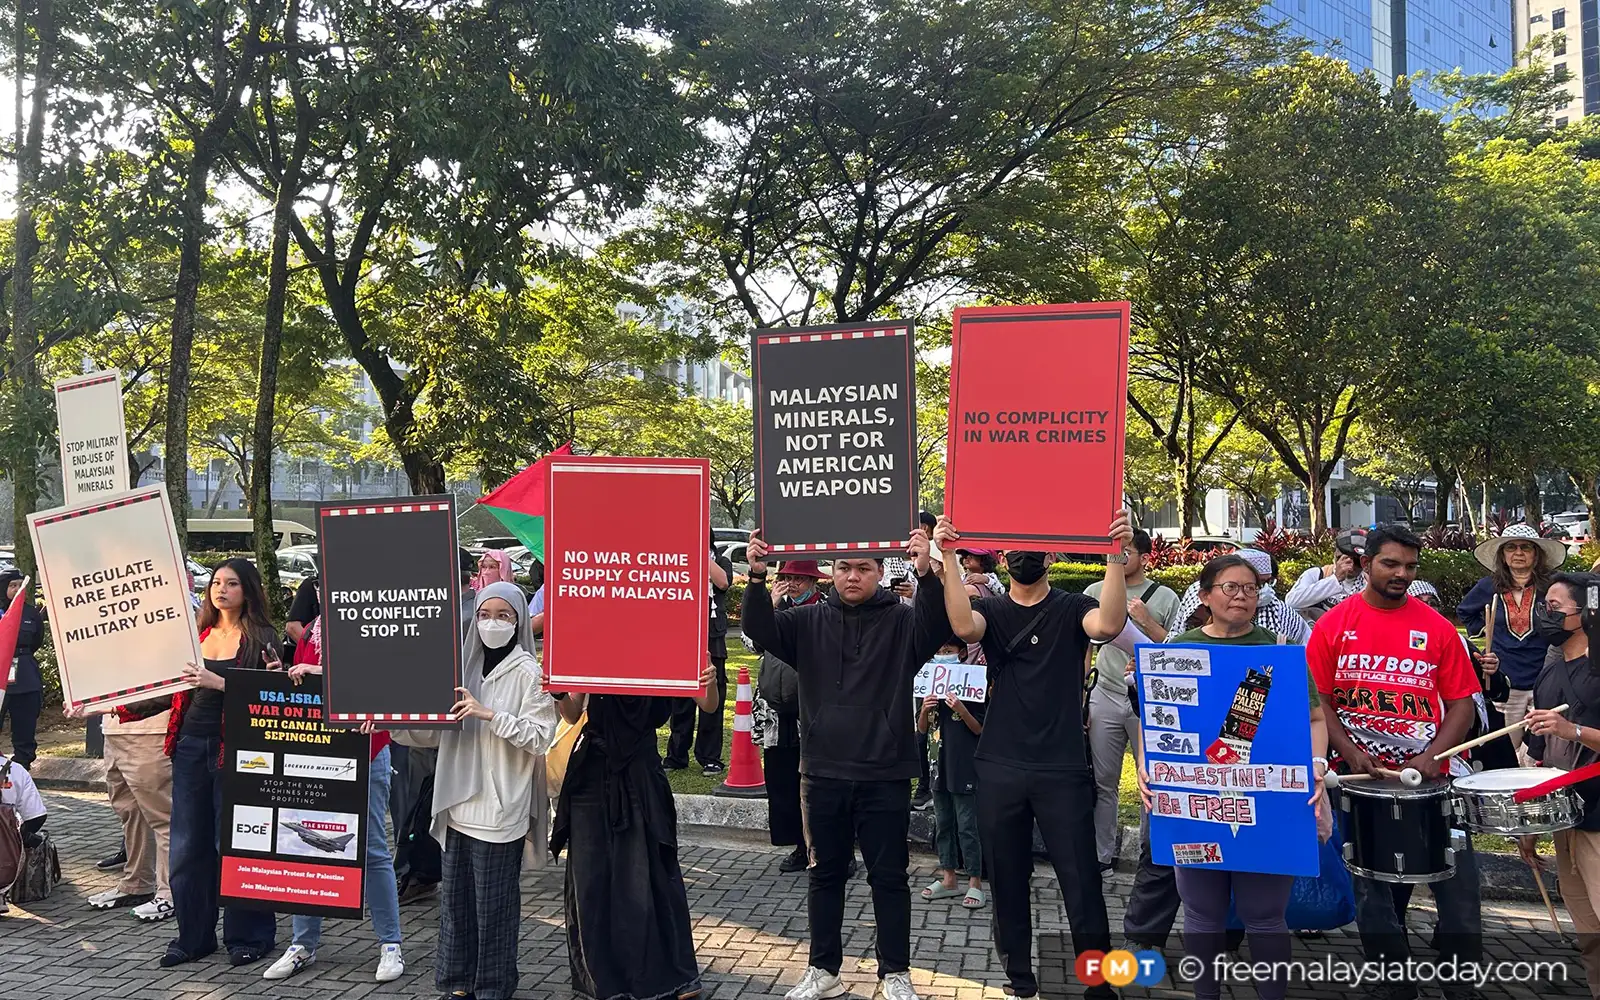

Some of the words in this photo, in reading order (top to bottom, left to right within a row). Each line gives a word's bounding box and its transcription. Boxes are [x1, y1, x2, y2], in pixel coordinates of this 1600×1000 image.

[770, 383, 898, 407] MALAYSIAN
[774, 407, 895, 429] MINERALS,
[964, 411, 990, 425] NO
[996, 410, 1109, 425] COMPLICITY
[786, 433, 832, 452] NOT
[839, 431, 885, 449] FOR
[964, 430, 982, 443] IN
[988, 430, 1030, 443] WAR
[1035, 429, 1106, 443] CRIMES
[66, 441, 85, 453] STOP
[86, 436, 119, 450] MILITARY
[72, 452, 103, 466] END-USE
[104, 451, 115, 461] OF
[776, 453, 894, 475] AMERICAN
[74, 465, 115, 479] MALAYSIAN
[77, 479, 114, 493] MINERALS
[779, 477, 893, 498] WEAPONS
[564, 551, 589, 564] NO
[593, 552, 632, 565] WAR
[636, 553, 689, 567] CRIME
[72, 559, 154, 590] REGULATE
[562, 568, 623, 582] SUPPLY
[628, 570, 691, 584] CHAINS
[63, 588, 106, 609] RARE
[111, 574, 169, 598] EARTH.
[331, 590, 373, 604] FROM
[377, 588, 448, 603] KUANTAN
[558, 585, 605, 598] FROM
[611, 587, 694, 601] MALAYSIA
[98, 598, 141, 618] STOP
[337, 608, 358, 620] TO
[362, 606, 442, 620] CONFLICT?
[65, 615, 139, 644] MILITARY
[144, 606, 181, 625] USE.
[360, 624, 399, 637] STOP
[403, 624, 420, 637] IT.
[1149, 651, 1203, 672] From
[1337, 654, 1437, 677] VERYBODY
[931, 665, 984, 700] Palestine
[1363, 673, 1387, 681] PLACE
[1397, 676, 1417, 685] OURS
[1150, 678, 1197, 703] River
[1236, 687, 1249, 698] ALL
[1250, 691, 1266, 703] OUT
[1233, 694, 1265, 712] PALEST
[248, 704, 280, 716] WAR
[283, 706, 303, 718] ON
[307, 708, 324, 719] IR
[1151, 706, 1175, 726] to
[250, 717, 278, 729] ROTI
[281, 719, 318, 731] CANAI
[264, 730, 332, 745] SEPINGGAN
[260, 787, 301, 796] MACHINES
[271, 795, 315, 805] PROFITING
[1188, 794, 1253, 824] FREE
[236, 823, 267, 835] EDGE
[316, 823, 345, 831] SYSTEMS
[237, 865, 251, 873] Join
[251, 866, 283, 876] Malaysian
[283, 869, 305, 878] Protest
[306, 871, 316, 879] for
[316, 873, 345, 881] Palestine
[241, 882, 254, 890] Join
[254, 884, 286, 893] Malaysian
[286, 887, 309, 895] Protest
[320, 890, 340, 898] Sudan
